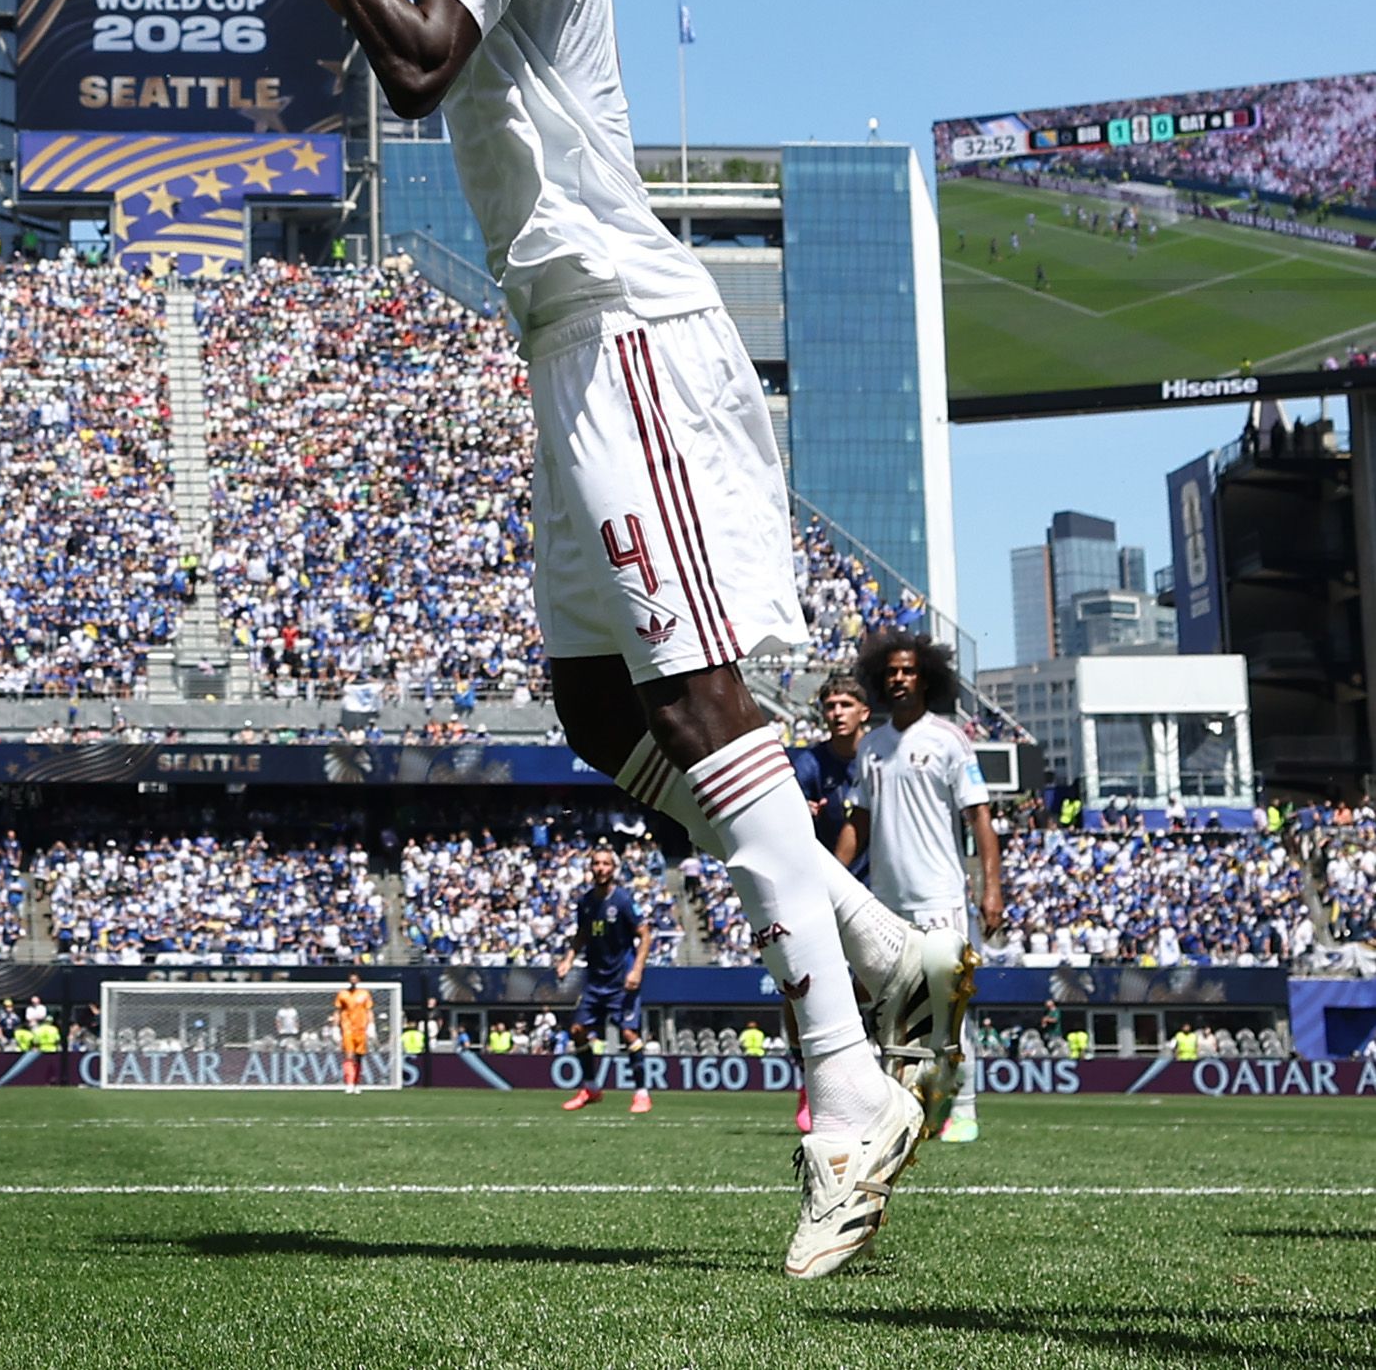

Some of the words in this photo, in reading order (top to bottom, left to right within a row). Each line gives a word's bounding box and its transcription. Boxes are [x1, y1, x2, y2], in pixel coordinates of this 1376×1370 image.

[93, 15, 267, 53] 2026
[79, 76, 281, 110] SEATTLE
[964, 135, 1017, 157] 32:52
[1162, 375, 1258, 400] Hisense
[600, 513, 662, 597] 4
[157, 752, 262, 773] SEATTLE
[79, 1051, 222, 1088] QATAR
[679, 1056, 749, 1091] 160
[1192, 1059, 1340, 1095] QATAR
